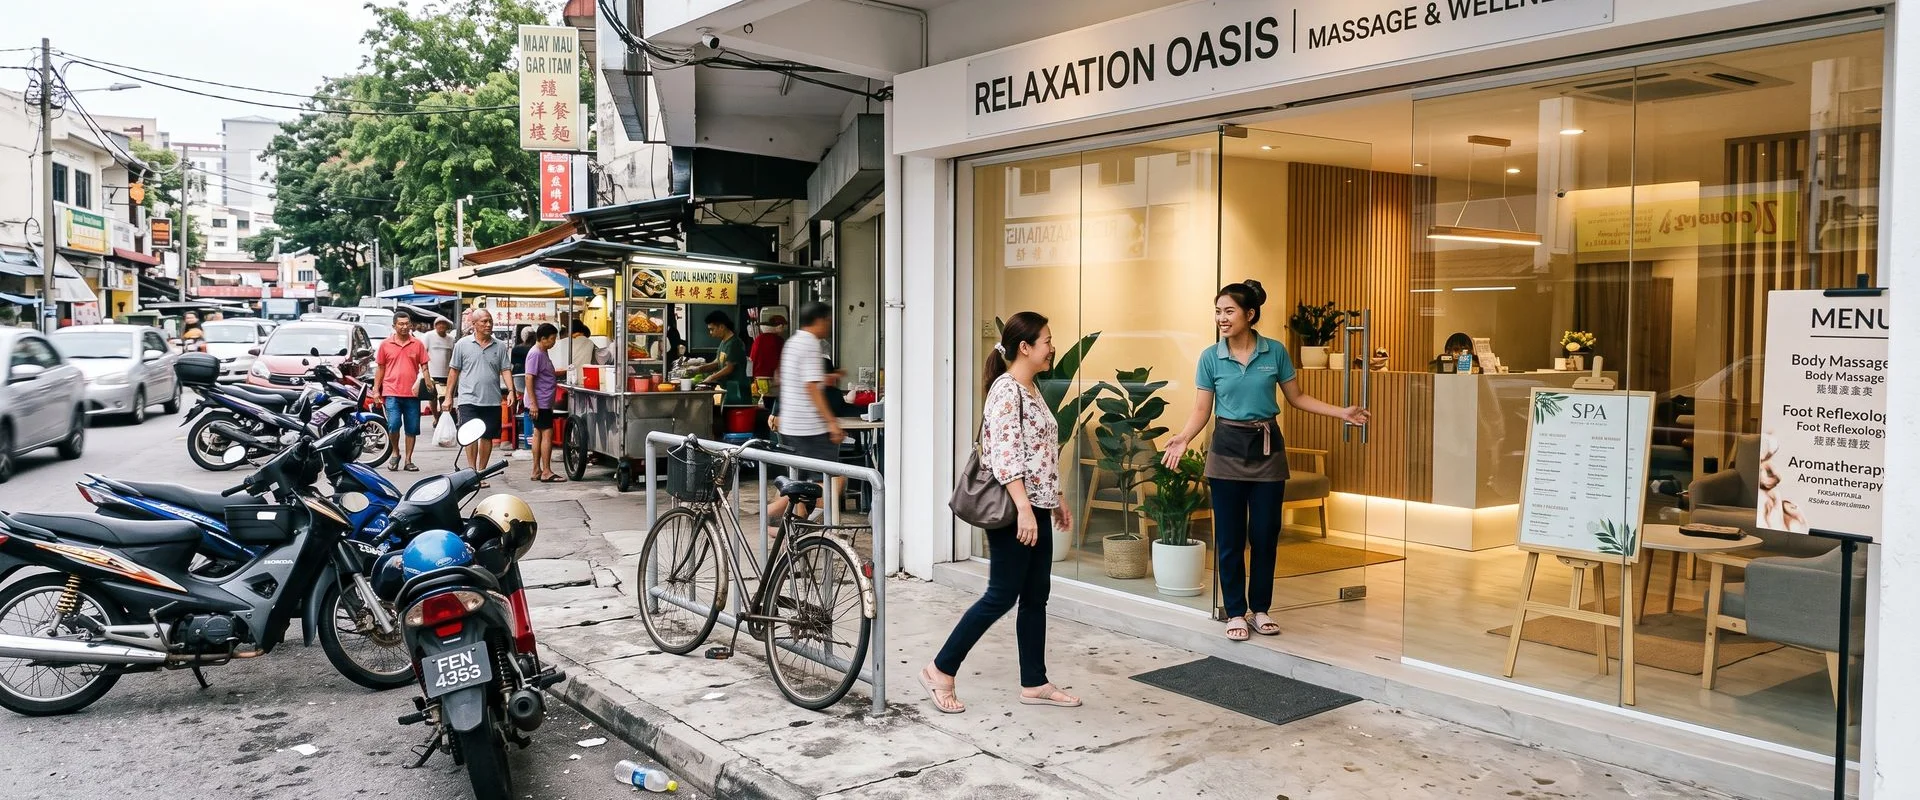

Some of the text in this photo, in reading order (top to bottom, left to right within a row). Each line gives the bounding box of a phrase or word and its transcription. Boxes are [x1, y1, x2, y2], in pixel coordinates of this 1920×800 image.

[1308, 6, 1418, 50] MASSAGE
[1424, 2, 1441, 26] &
[523, 34, 573, 53] MAAY MAU
[525, 56, 572, 74] GAR ITAM
[975, 16, 1279, 116] RELAXATION OASIS
[1811, 308, 1889, 330] MENU
[1791, 354, 1888, 371] Body Massage
[1805, 370, 1885, 385] Body Massage
[1571, 403, 1607, 420] SPA
[1783, 405, 1813, 418] Foot
[1796, 421, 1821, 432] Foot
[437, 650, 473, 673] FEN
[435, 664, 482, 688] 4353
